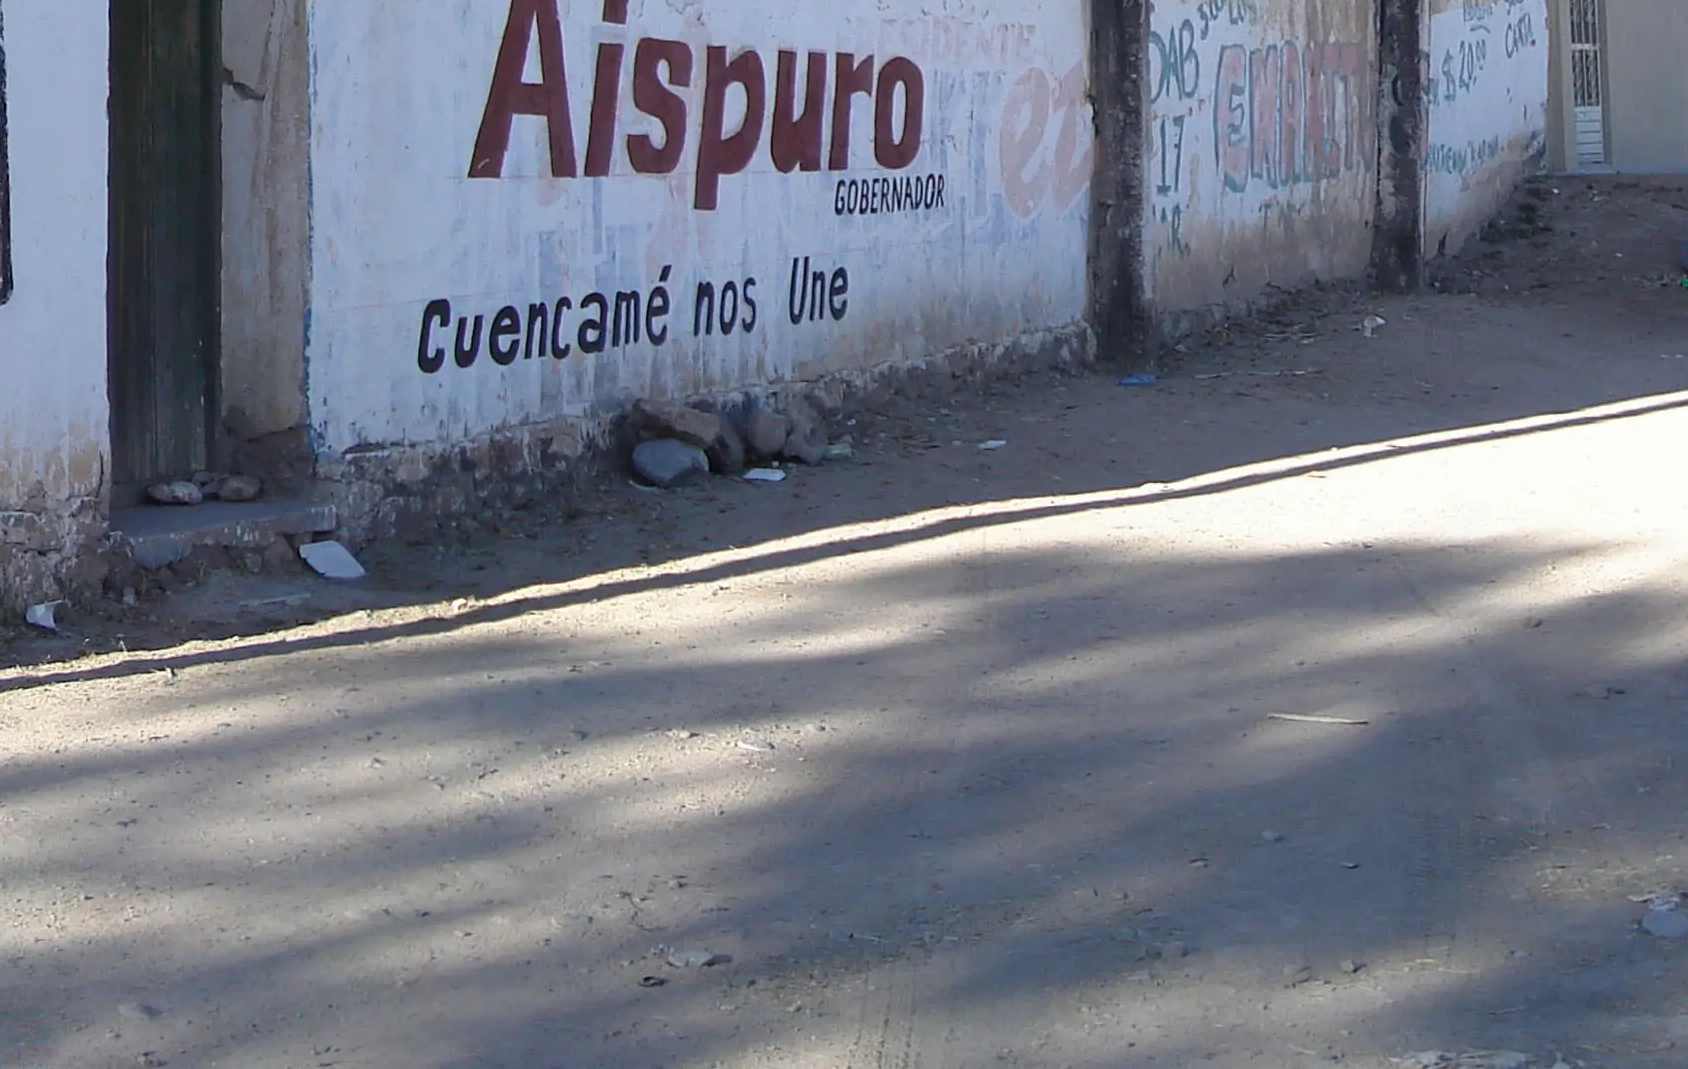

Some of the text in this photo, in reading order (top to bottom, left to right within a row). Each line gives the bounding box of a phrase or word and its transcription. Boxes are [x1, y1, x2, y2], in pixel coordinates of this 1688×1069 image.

[834, 173, 945, 216] GOBERNADOR
[417, 257, 849, 373] Cuencamé nos Une
